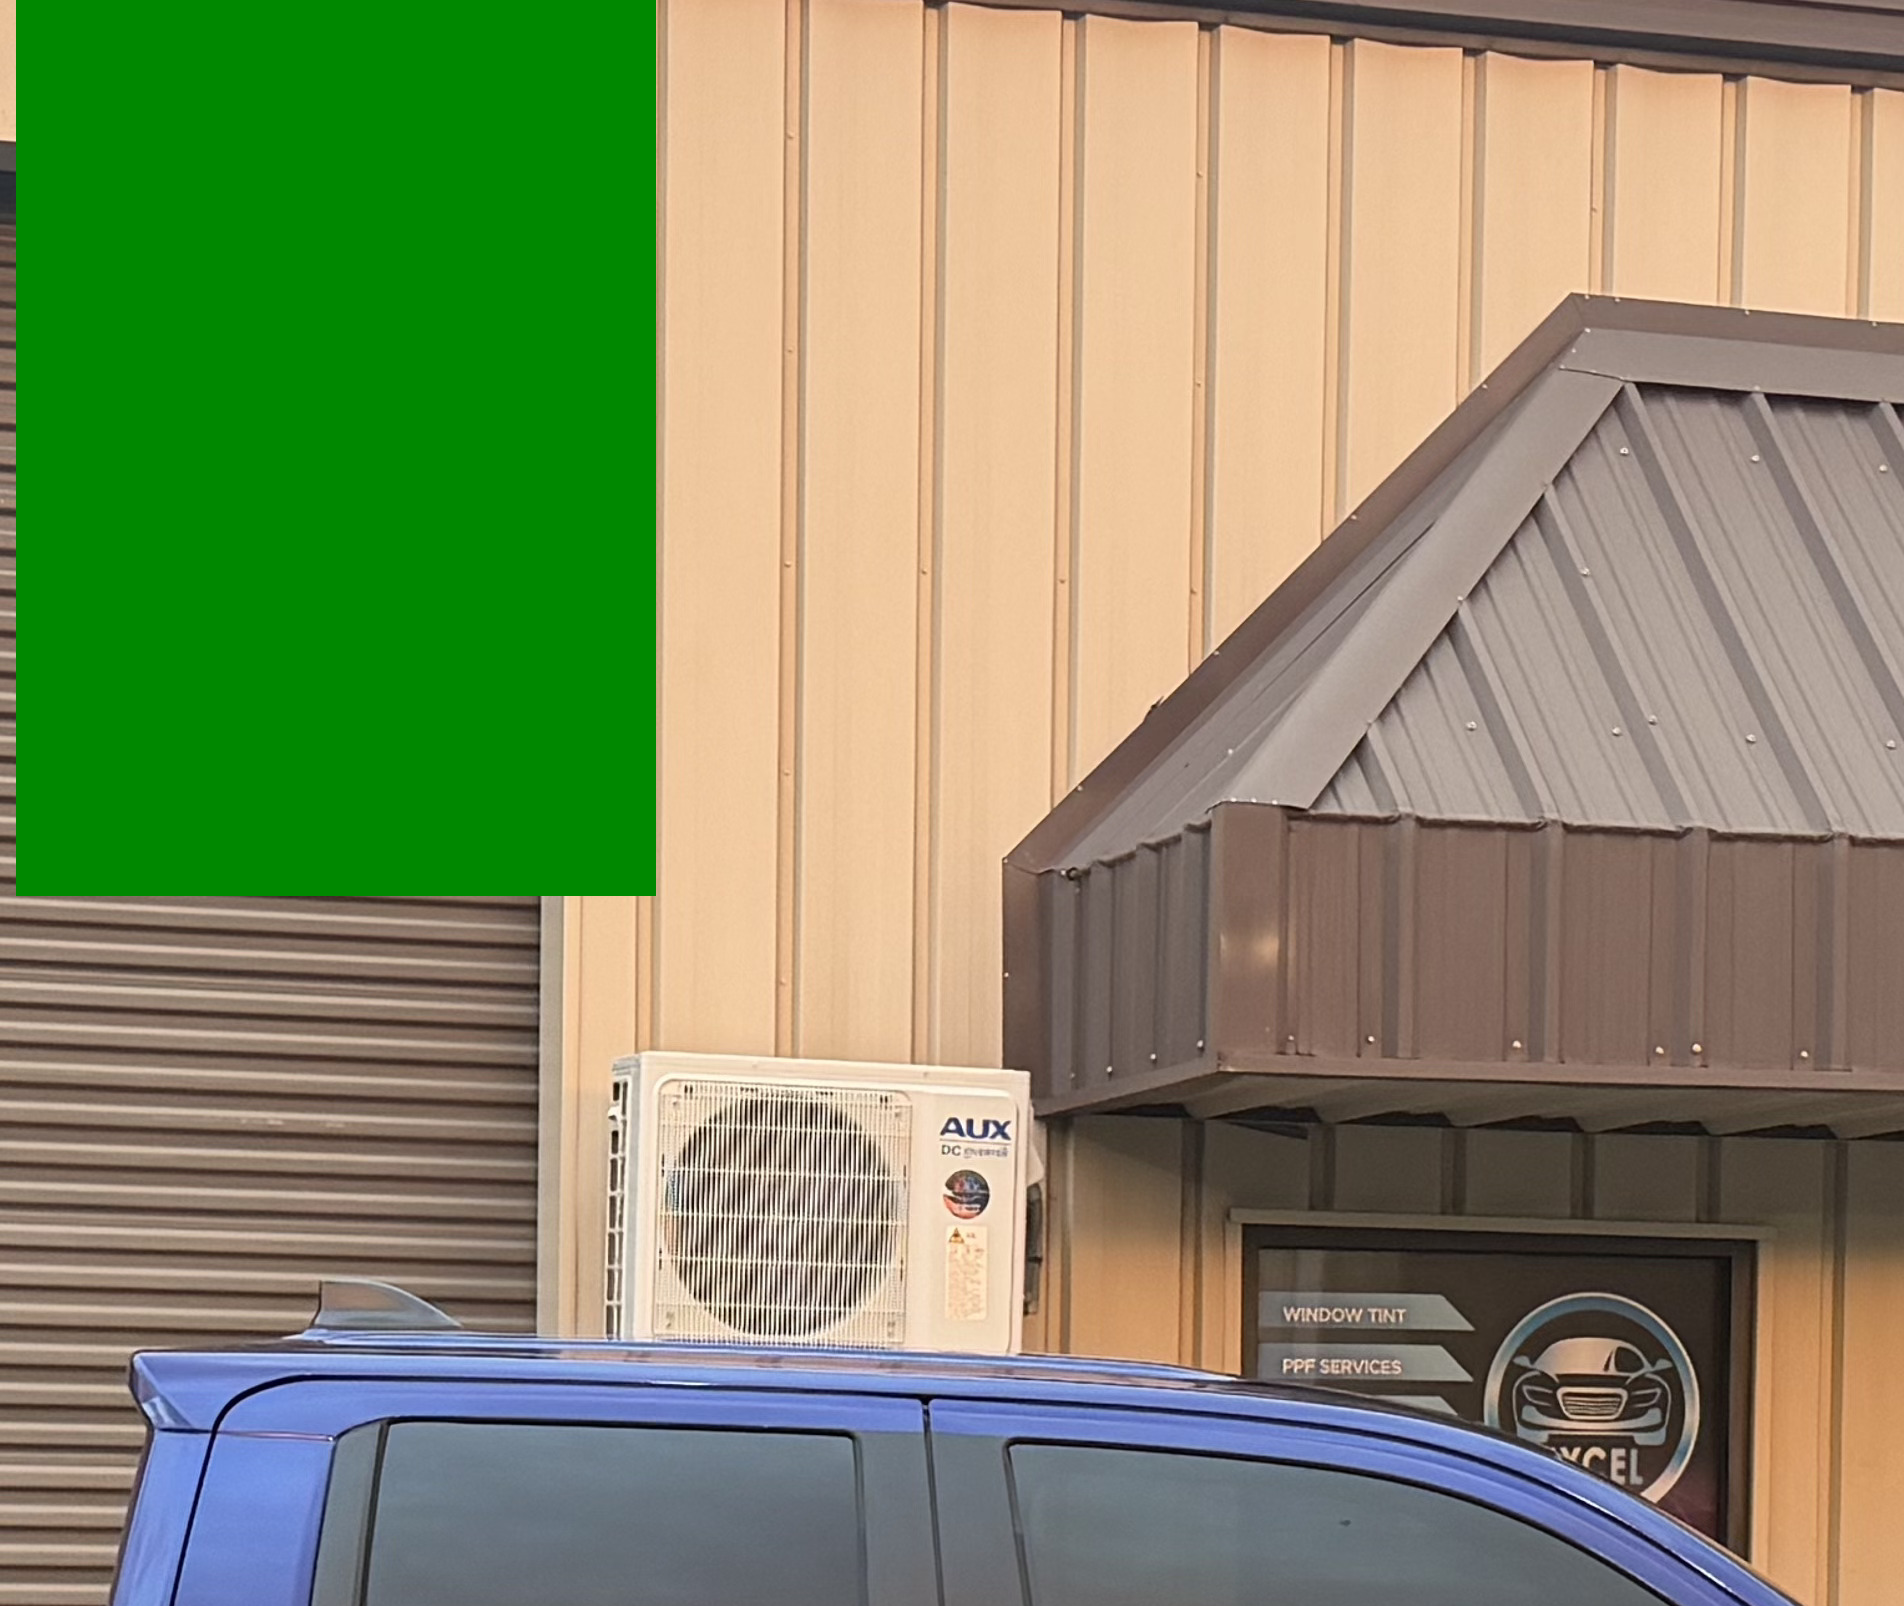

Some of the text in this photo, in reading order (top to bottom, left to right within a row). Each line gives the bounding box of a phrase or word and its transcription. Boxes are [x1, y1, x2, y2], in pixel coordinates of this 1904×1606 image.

[940, 1117, 1012, 1141] AUX
[941, 1144, 962, 1156] DC
[1282, 1306, 1407, 1323] WINDOW TINT
[1282, 1358, 1402, 1375] PPF SERVICES
[1554, 1446, 1644, 1485] CEL
